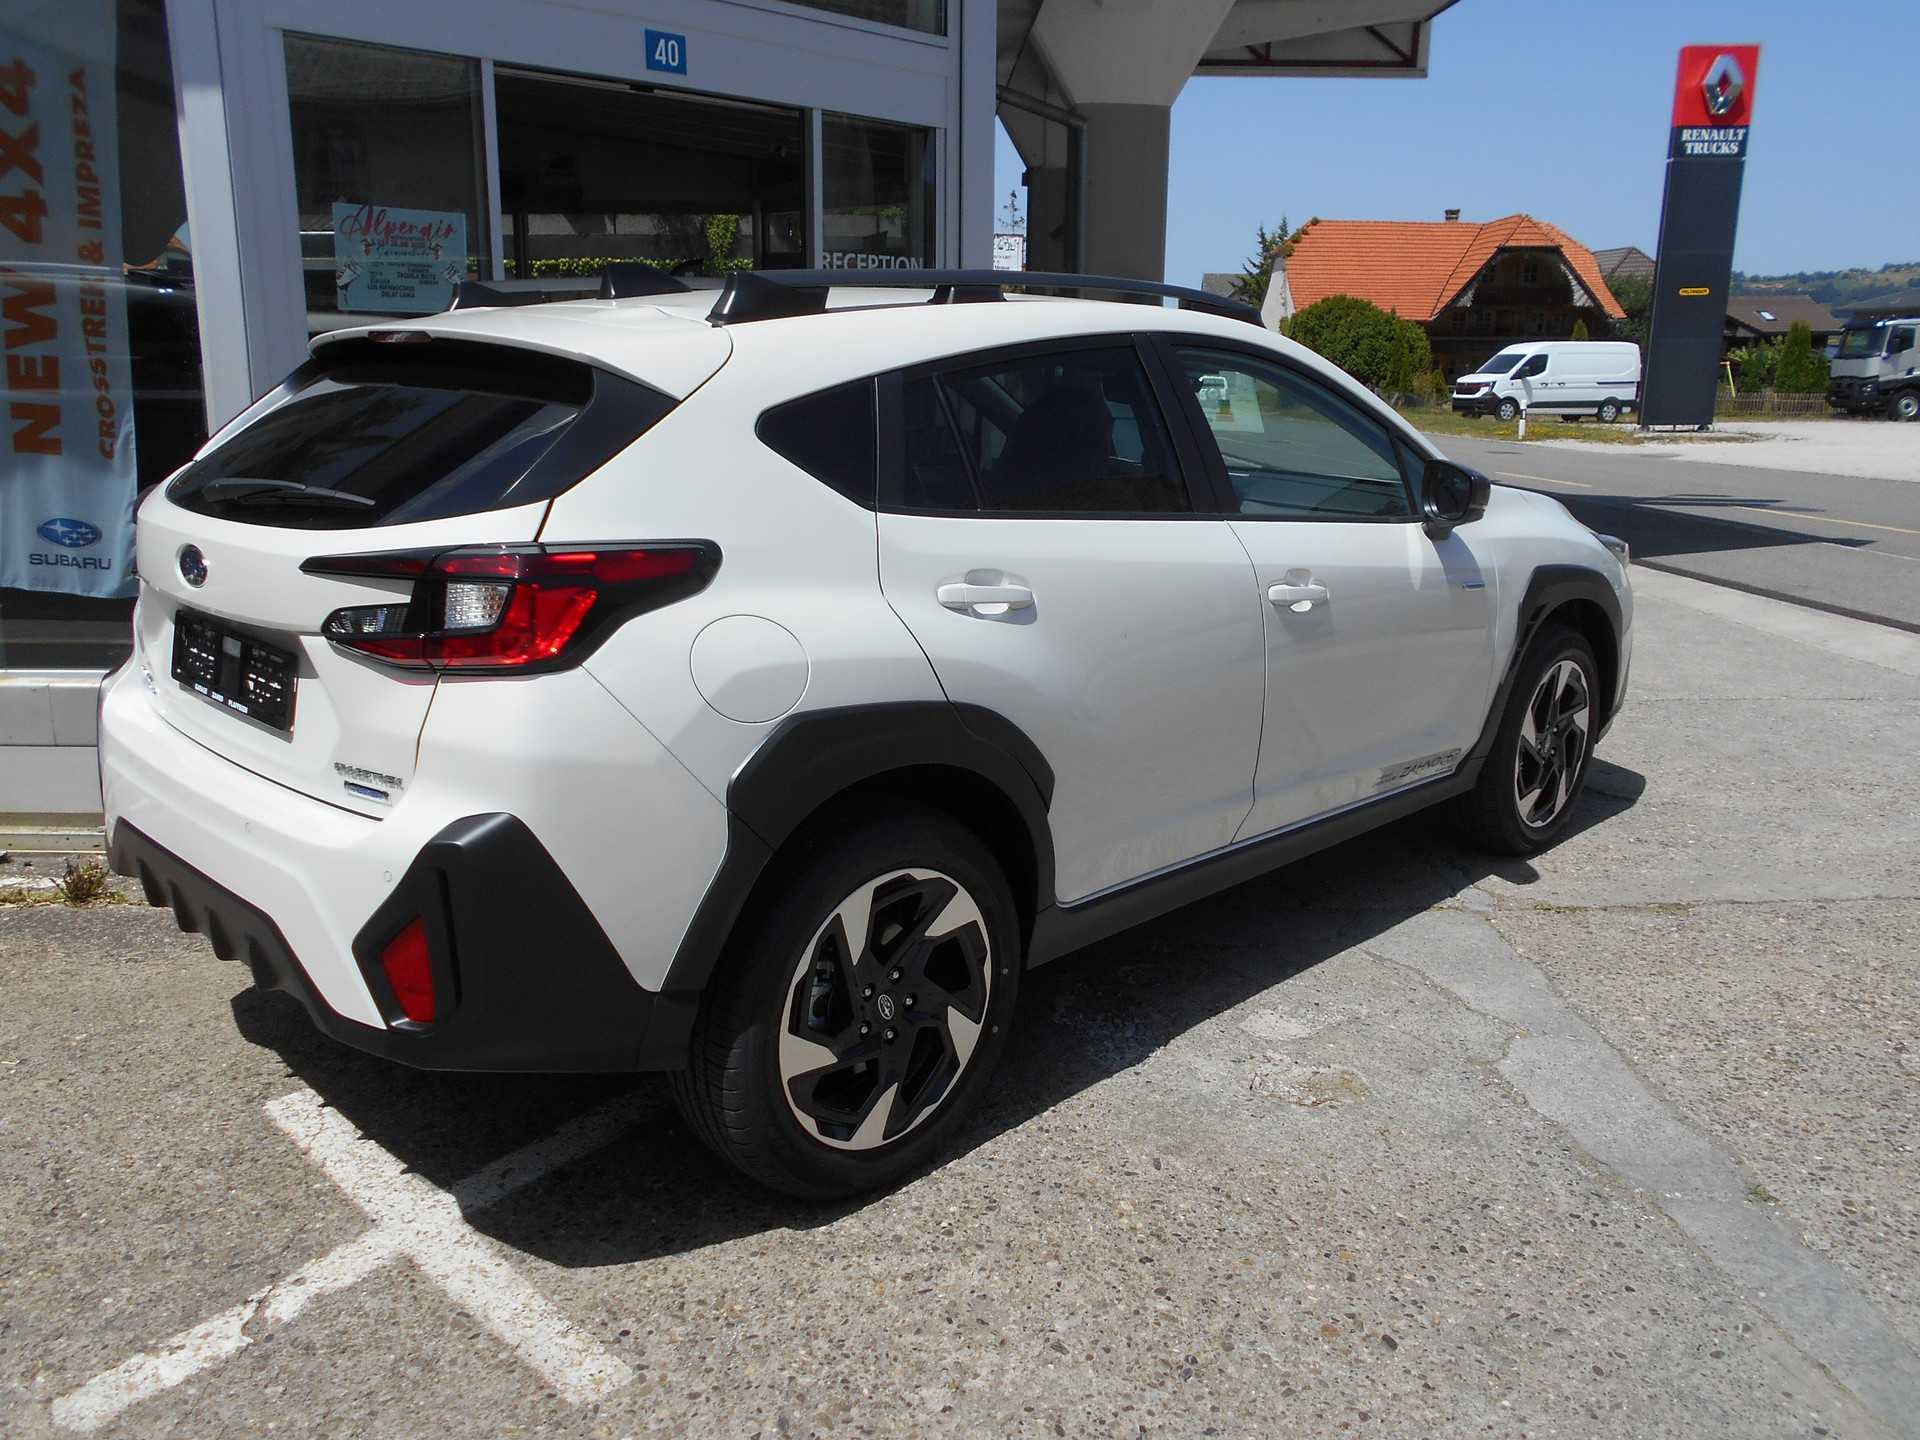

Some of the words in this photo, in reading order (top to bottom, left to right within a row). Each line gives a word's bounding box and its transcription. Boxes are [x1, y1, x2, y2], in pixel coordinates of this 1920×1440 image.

[655, 38, 679, 67] 40
[68, 67, 103, 230] IMPREZA
[1682, 128, 1746, 141] RENAULT
[1685, 141, 1739, 154] TRUCKS
[0, 57, 49, 245] 4X4
[340, 203, 457, 245] Alpenair
[78, 239, 104, 265] &
[822, 251, 925, 270] RECEPTION
[1, 264, 63, 456] NEW
[79, 271, 116, 460] CROSSTREK
[29, 553, 112, 570] SUBARU
